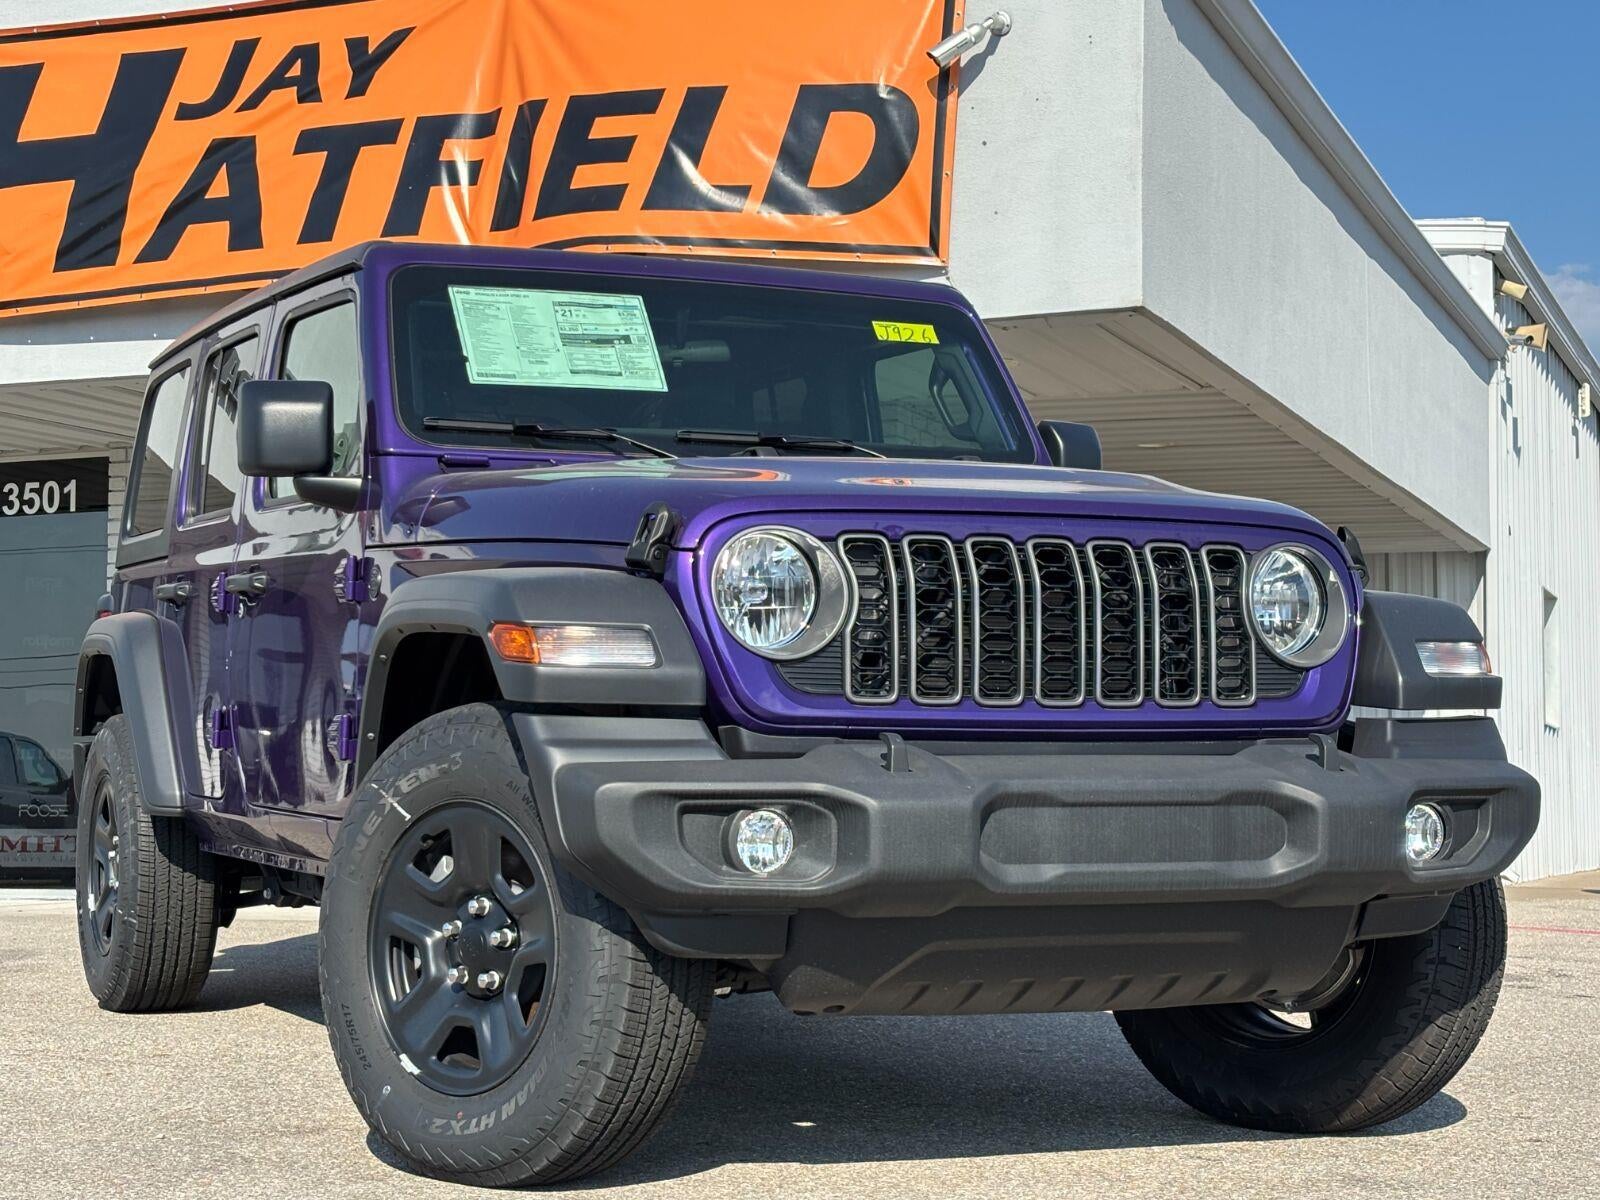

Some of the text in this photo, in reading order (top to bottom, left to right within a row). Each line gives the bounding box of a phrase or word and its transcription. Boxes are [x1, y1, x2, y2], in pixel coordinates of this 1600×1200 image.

[174, 26, 416, 121] JAY
[0, 47, 921, 273] HATFIELD
[878, 324, 932, 342] J926
[2, 478, 77, 516] 3501
[18, 804, 69, 817] FOOSE
[429, 1109, 498, 1137] HTX2
